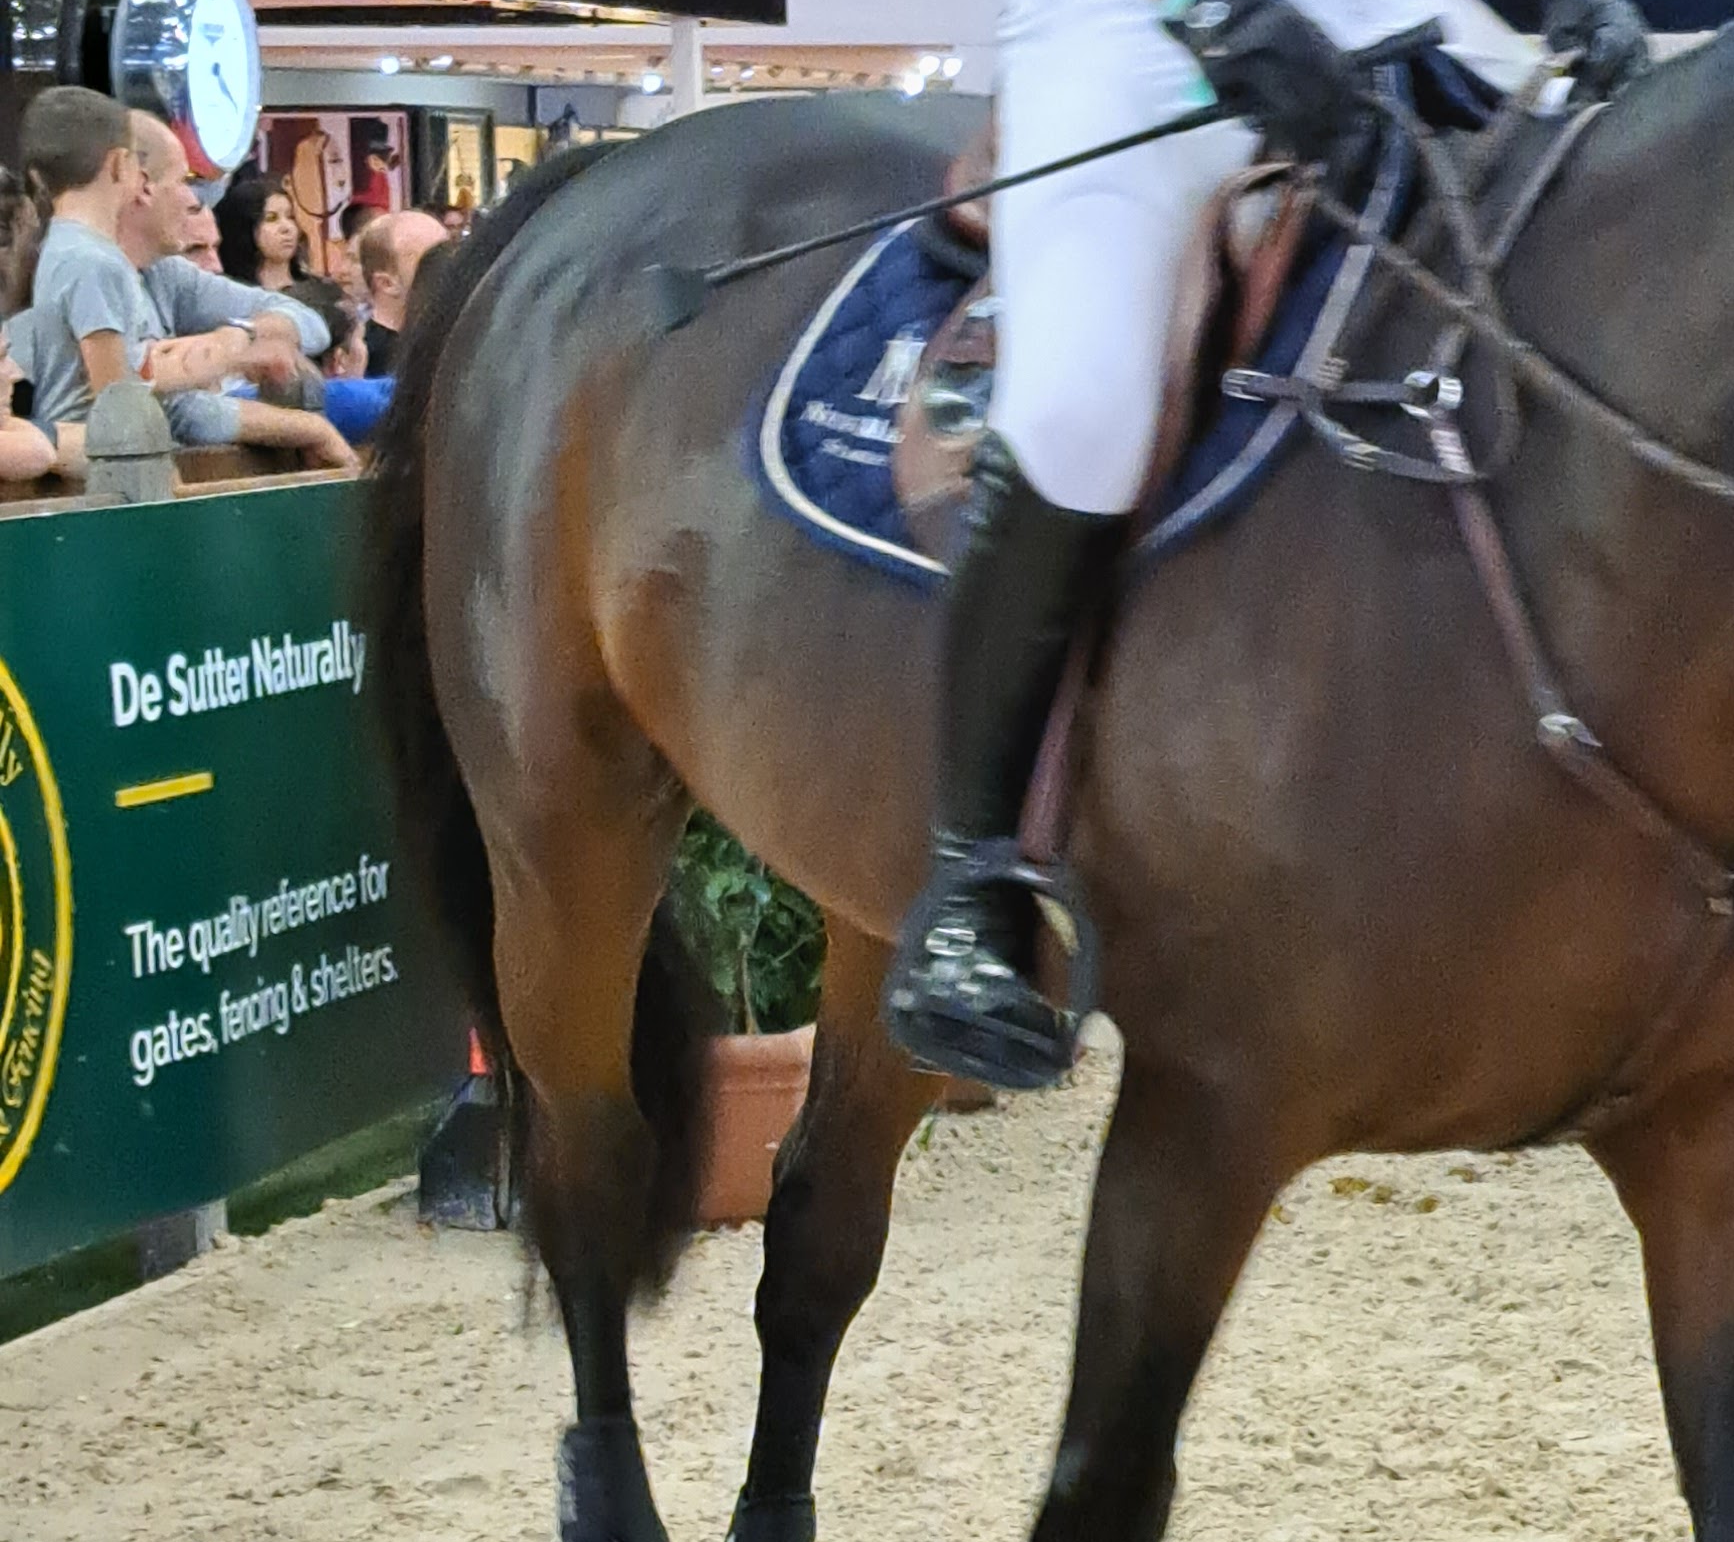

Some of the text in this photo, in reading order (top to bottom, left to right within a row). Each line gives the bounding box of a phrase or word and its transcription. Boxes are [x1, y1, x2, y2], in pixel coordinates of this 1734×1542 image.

[110, 619, 367, 728] De Sutter Naturally
[124, 854, 391, 978] The quality reference for
[130, 943, 399, 1087] gates, fencing & shelters.
